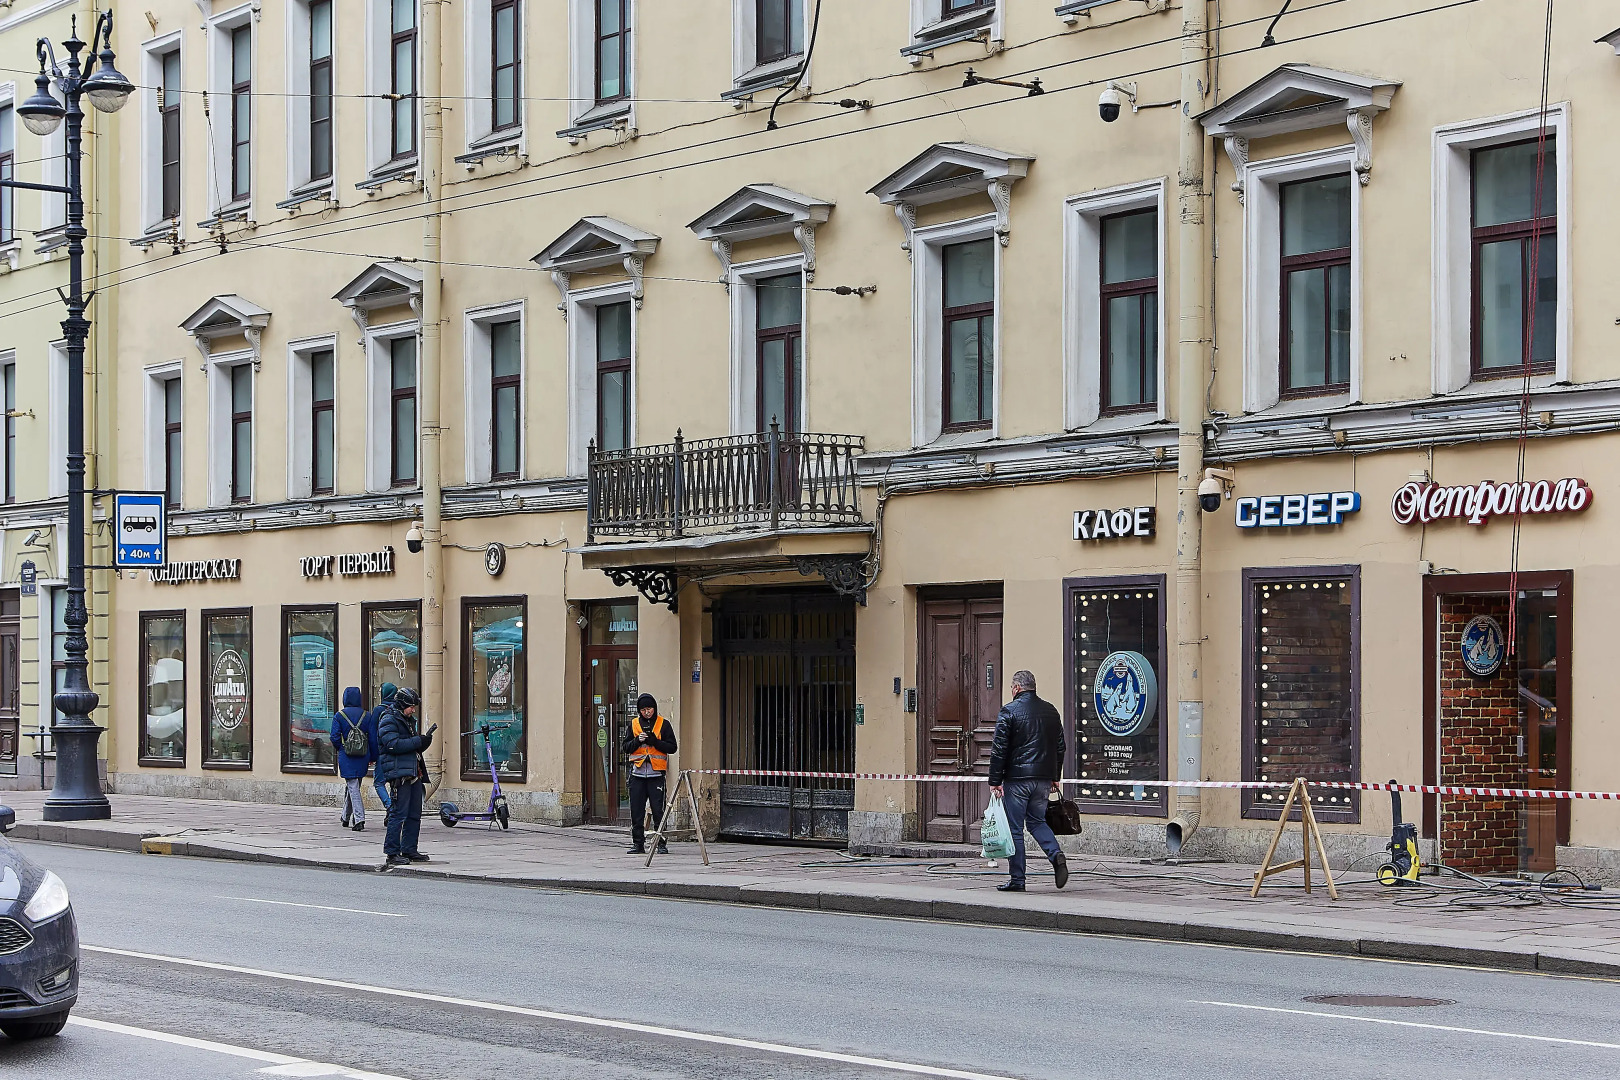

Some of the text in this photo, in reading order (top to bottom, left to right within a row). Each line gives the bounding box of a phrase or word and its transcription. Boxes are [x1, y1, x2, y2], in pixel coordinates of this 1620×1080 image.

[1236, 491, 1359, 528] СЕВЕР
[1391, 479, 1591, 525] Метрополь
[1073, 507, 1153, 540] КАФЕ
[299, 545, 393, 577] ТОРТ ПЕРВЫЙ
[609, 618, 638, 632] LAVAZZA
[214, 677, 246, 696] LAVAZZA
[1103, 744, 1133, 752] ОСНОВАНО
